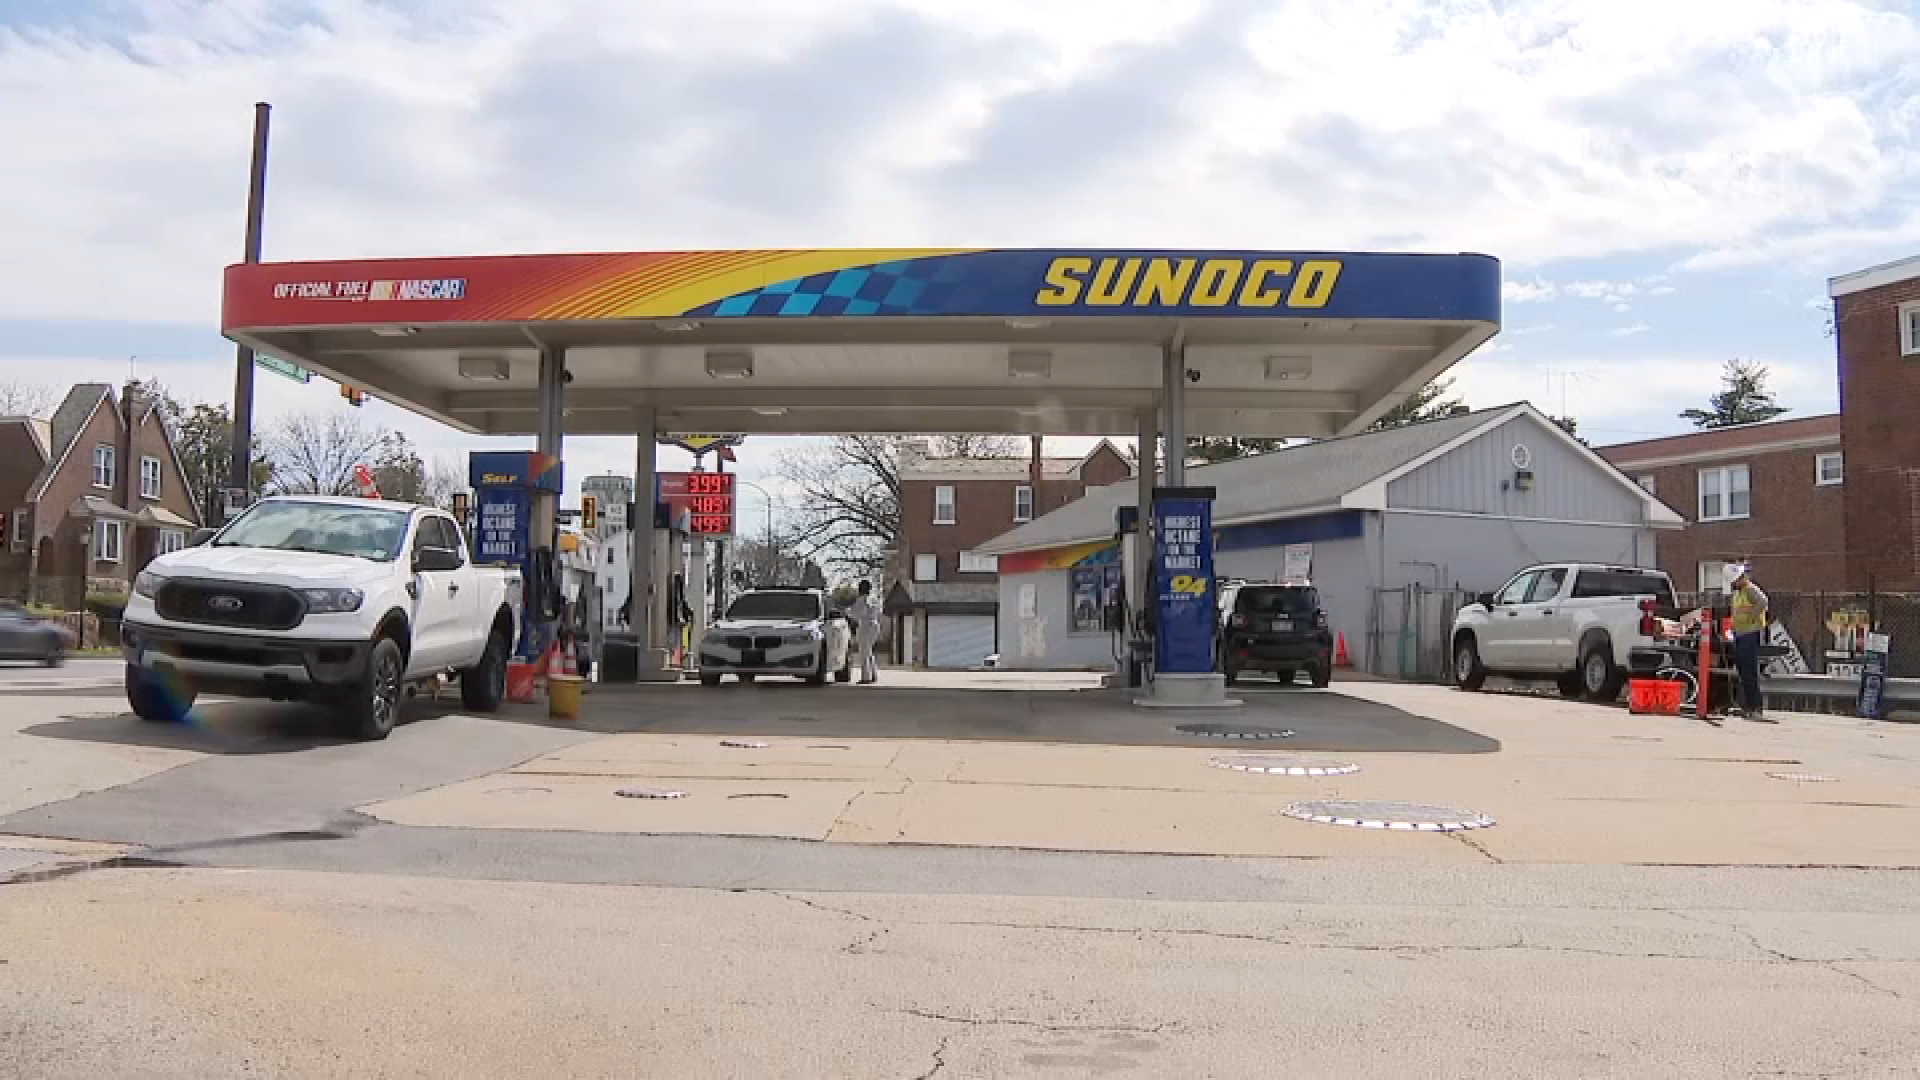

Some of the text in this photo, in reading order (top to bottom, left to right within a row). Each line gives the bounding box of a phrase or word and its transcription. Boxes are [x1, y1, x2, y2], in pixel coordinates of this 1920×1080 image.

[274, 279, 467, 300] OFFICIAL FUEL NASCAR
[1035, 256, 1344, 308] SUNOCO
[1171, 575, 1207, 597] 94
